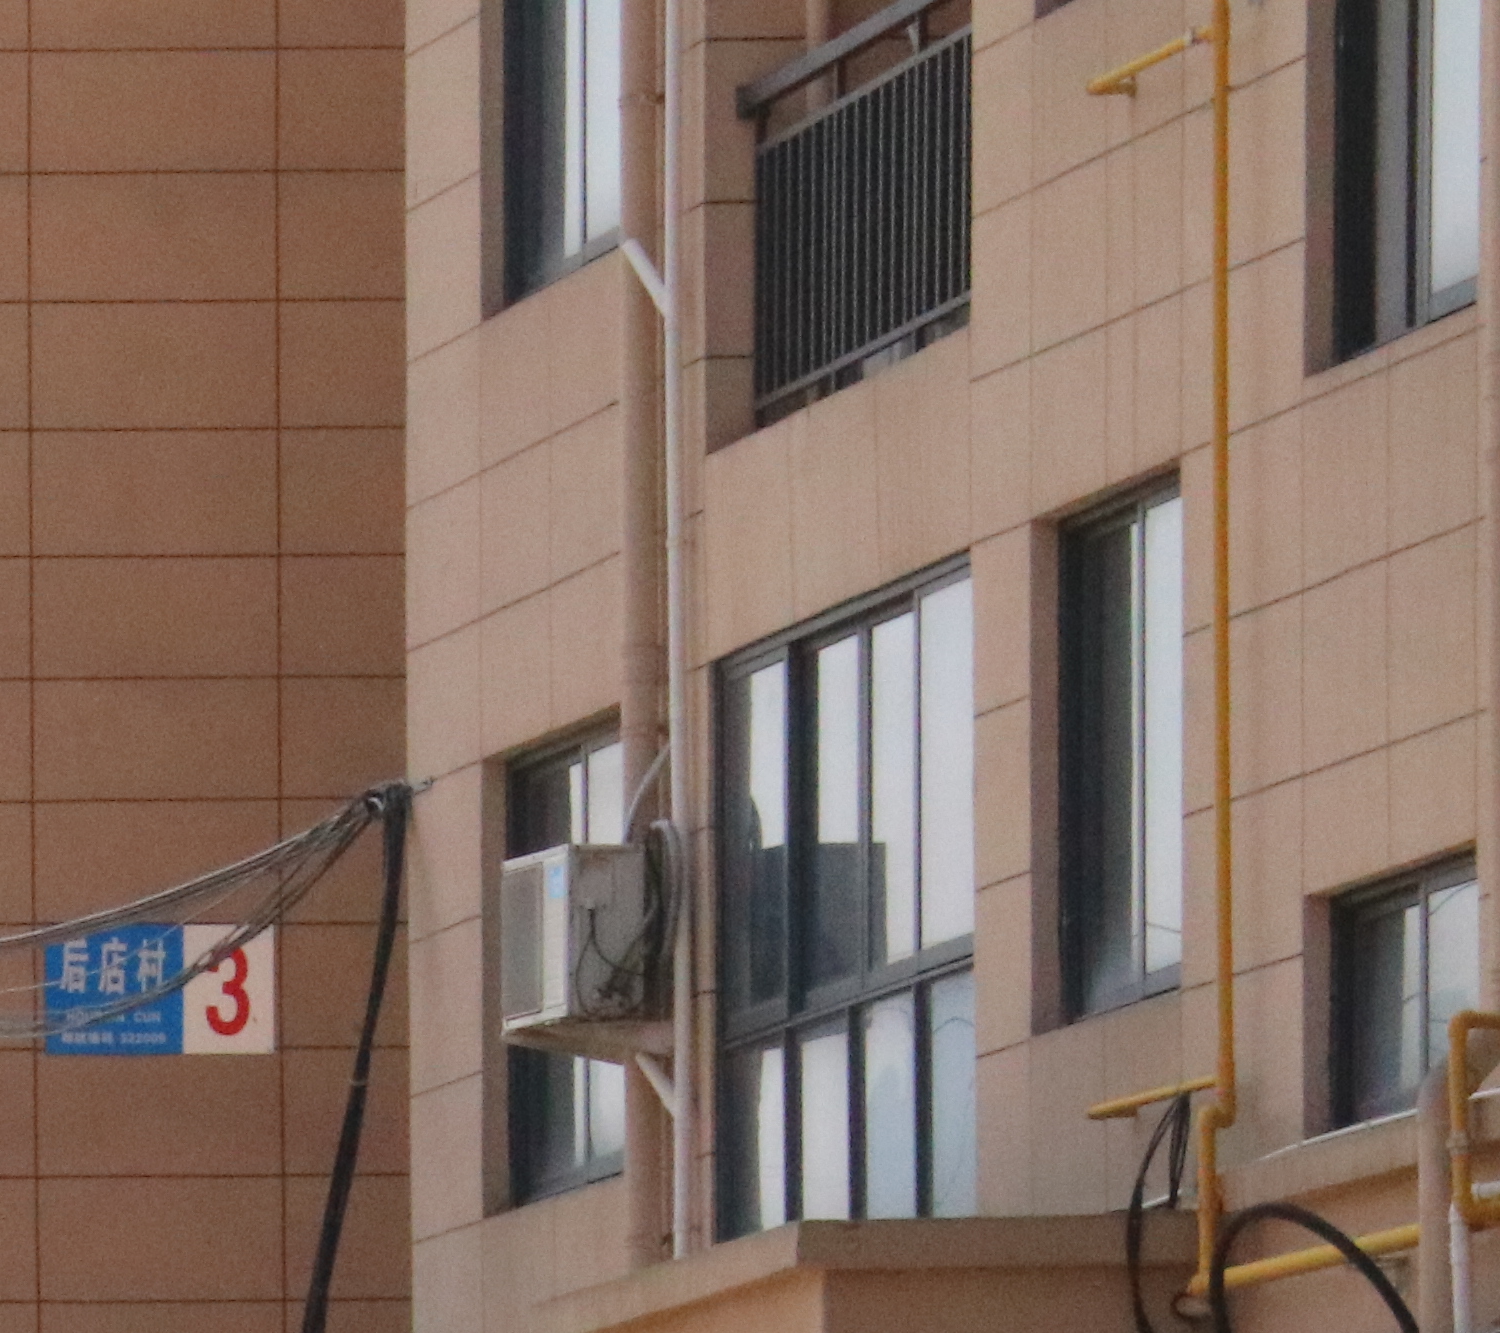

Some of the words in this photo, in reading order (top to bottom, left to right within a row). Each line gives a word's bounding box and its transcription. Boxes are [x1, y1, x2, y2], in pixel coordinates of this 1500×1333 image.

[60, 937, 167, 994] 后店村
[205, 946, 250, 1036] 3
